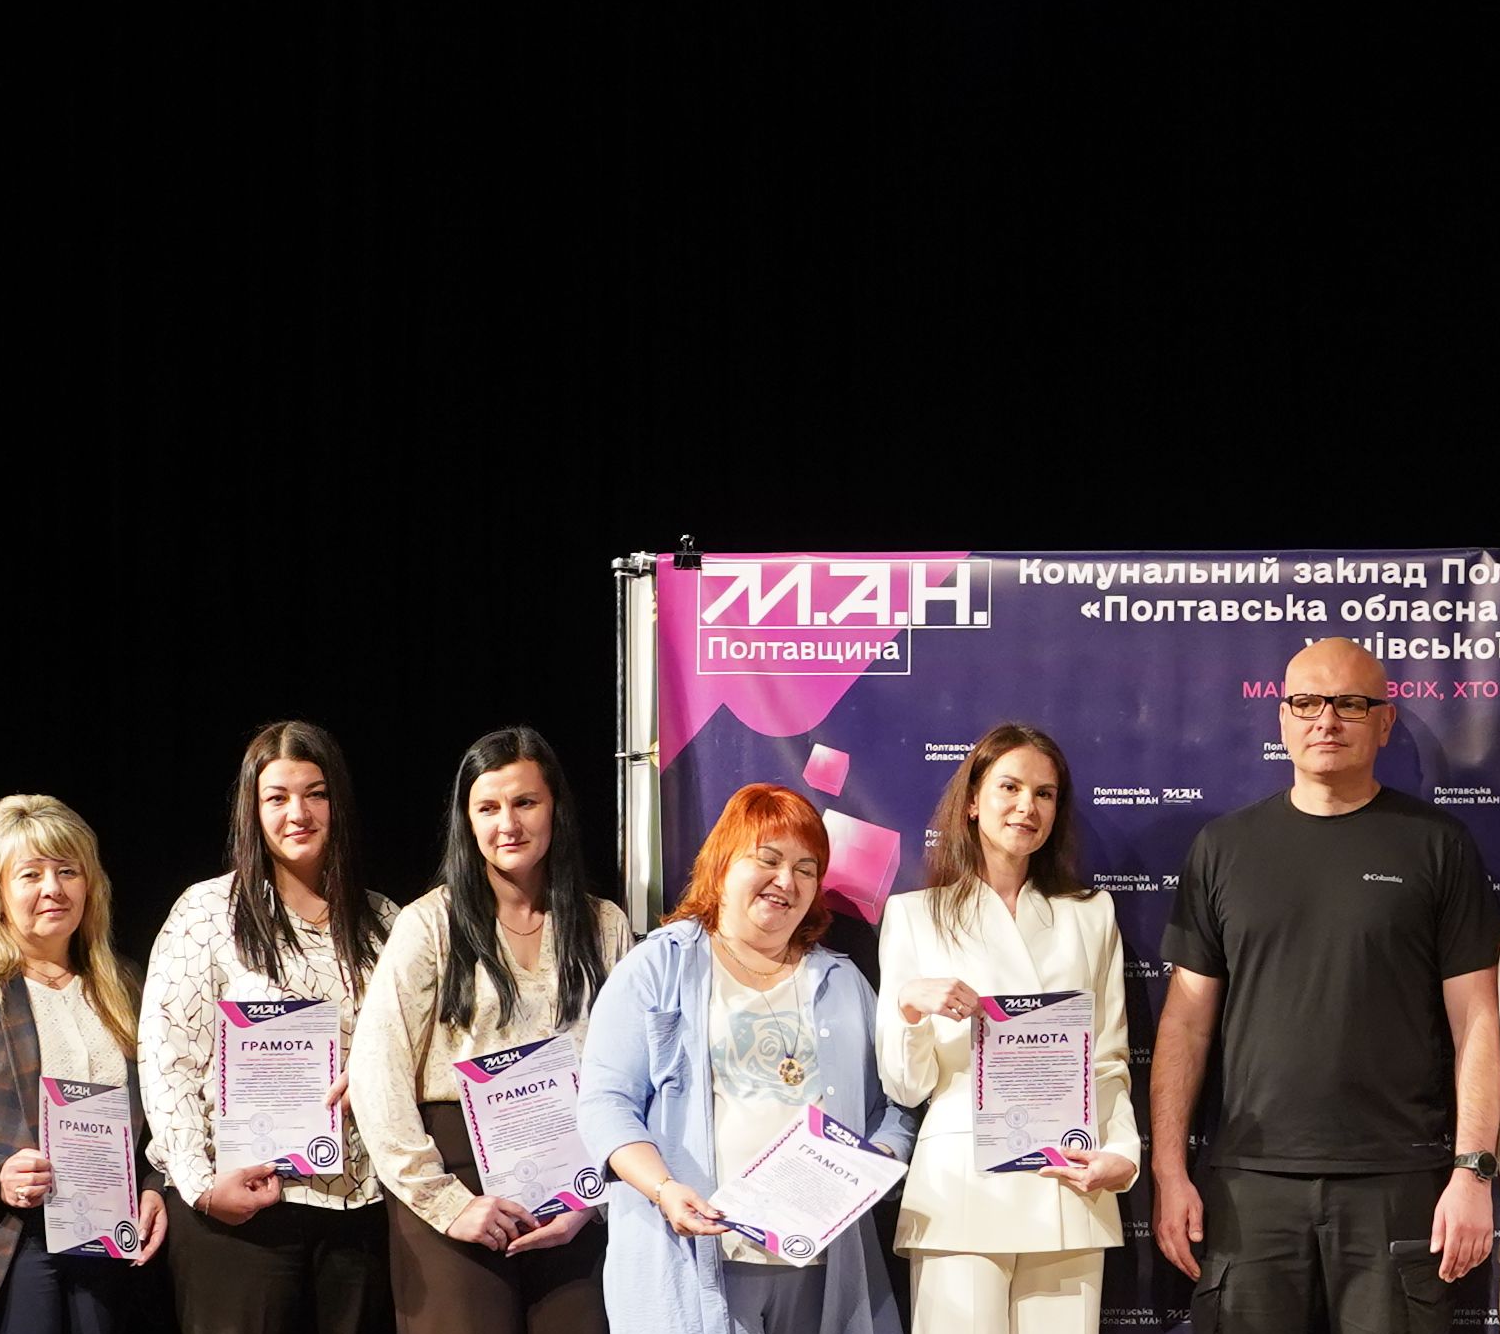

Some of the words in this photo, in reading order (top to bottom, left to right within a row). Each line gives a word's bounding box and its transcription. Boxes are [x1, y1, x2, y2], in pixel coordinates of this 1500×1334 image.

[1019, 557, 1280, 590] Комунальний
[1293, 557, 1428, 588] заклад
[1080, 593, 1328, 622] «Полтавська
[1340, 593, 1498, 622] обласна
[707, 636, 901, 664] Полтавщина
[1454, 681, 1499, 698] ХТО
[1136, 797, 1159, 805] МАН
[241, 1039, 315, 1052] ГРАМОТА
[998, 1032, 1069, 1045] ГРАМОТА
[486, 1078, 558, 1105] ГРАМОТА
[59, 1119, 113, 1136] ГРАМОТА
[798, 1143, 860, 1186] ГРАМОТА
